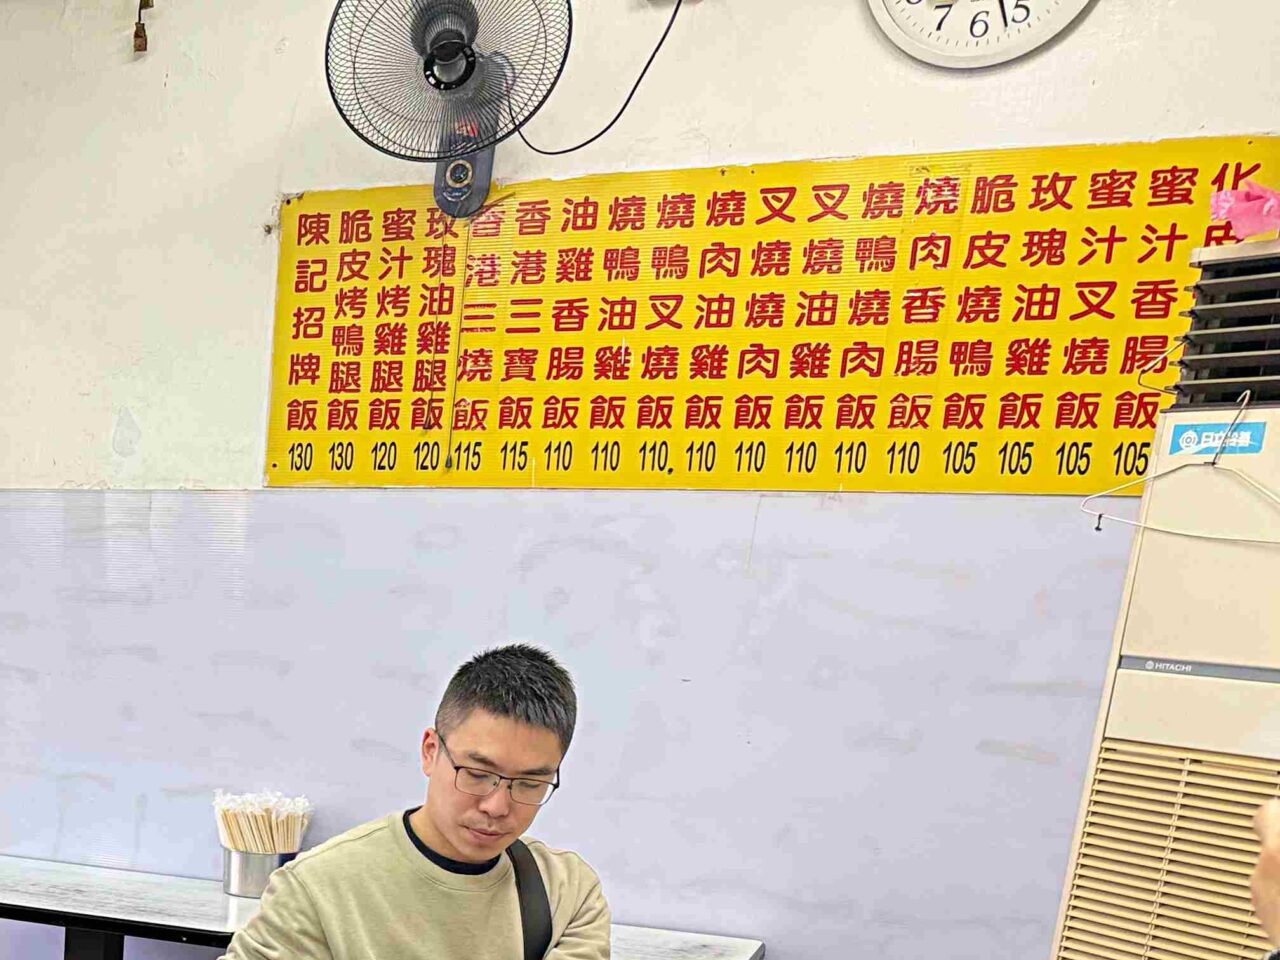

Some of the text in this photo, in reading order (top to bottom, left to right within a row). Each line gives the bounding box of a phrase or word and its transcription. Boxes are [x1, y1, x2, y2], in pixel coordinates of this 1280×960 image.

[933, 4, 953, 32] 7
[970, 10, 990, 38] 6
[498, 199, 551, 430] 香港三寶飯
[542, 196, 599, 429] 油雞香腸飯
[589, 195, 646, 429] 燒鴨油雞飯
[636, 192, 695, 429] 燒鴨叉燒飯
[684, 189, 746, 430] 燒肉油雞飯
[733, 186, 797, 430] 叉燒燒肉飯
[784, 183, 849, 430] 叉燒油雞飯
[835, 181, 905, 430] 燒鴨燒肉飯
[887, 176, 959, 429] 燒肉香腸飯
[942, 174, 1019, 430] 脆皮燒鴨飯
[998, 171, 1078, 430] 玫瑰油雞飯
[1054, 168, 1138, 429] 蜜汁叉燒飯
[1113, 165, 1200, 430] 蜜汁香腸飯
[287, 212, 330, 431] 陳記招牌飯
[327, 209, 372, 431] 脆皮烤鴨腿飯
[368, 207, 417, 431] 蜜汁烤雞腿飯
[452, 204, 502, 431] 香港三燒飯
[288, 442, 313, 471] 130
[328, 441, 354, 471] 130
[371, 441, 397, 471] 120
[413, 441, 440, 471] 120
[454, 441, 482, 471] 115
[500, 441, 529, 471] 115
[544, 440, 573, 471] 110
[591, 441, 620, 471] 110
[639, 440, 668, 472] 110
[686, 441, 716, 472] 110
[735, 441, 766, 473] 110
[785, 441, 817, 473] 110
[834, 441, 867, 474] 110
[887, 441, 920, 474] 110
[943, 441, 978, 475] 105
[998, 441, 1034, 475] 105
[1056, 441, 1093, 476] 105
[1113, 441, 1151, 476] 105
[1155, 662, 1192, 672] HITACHI
